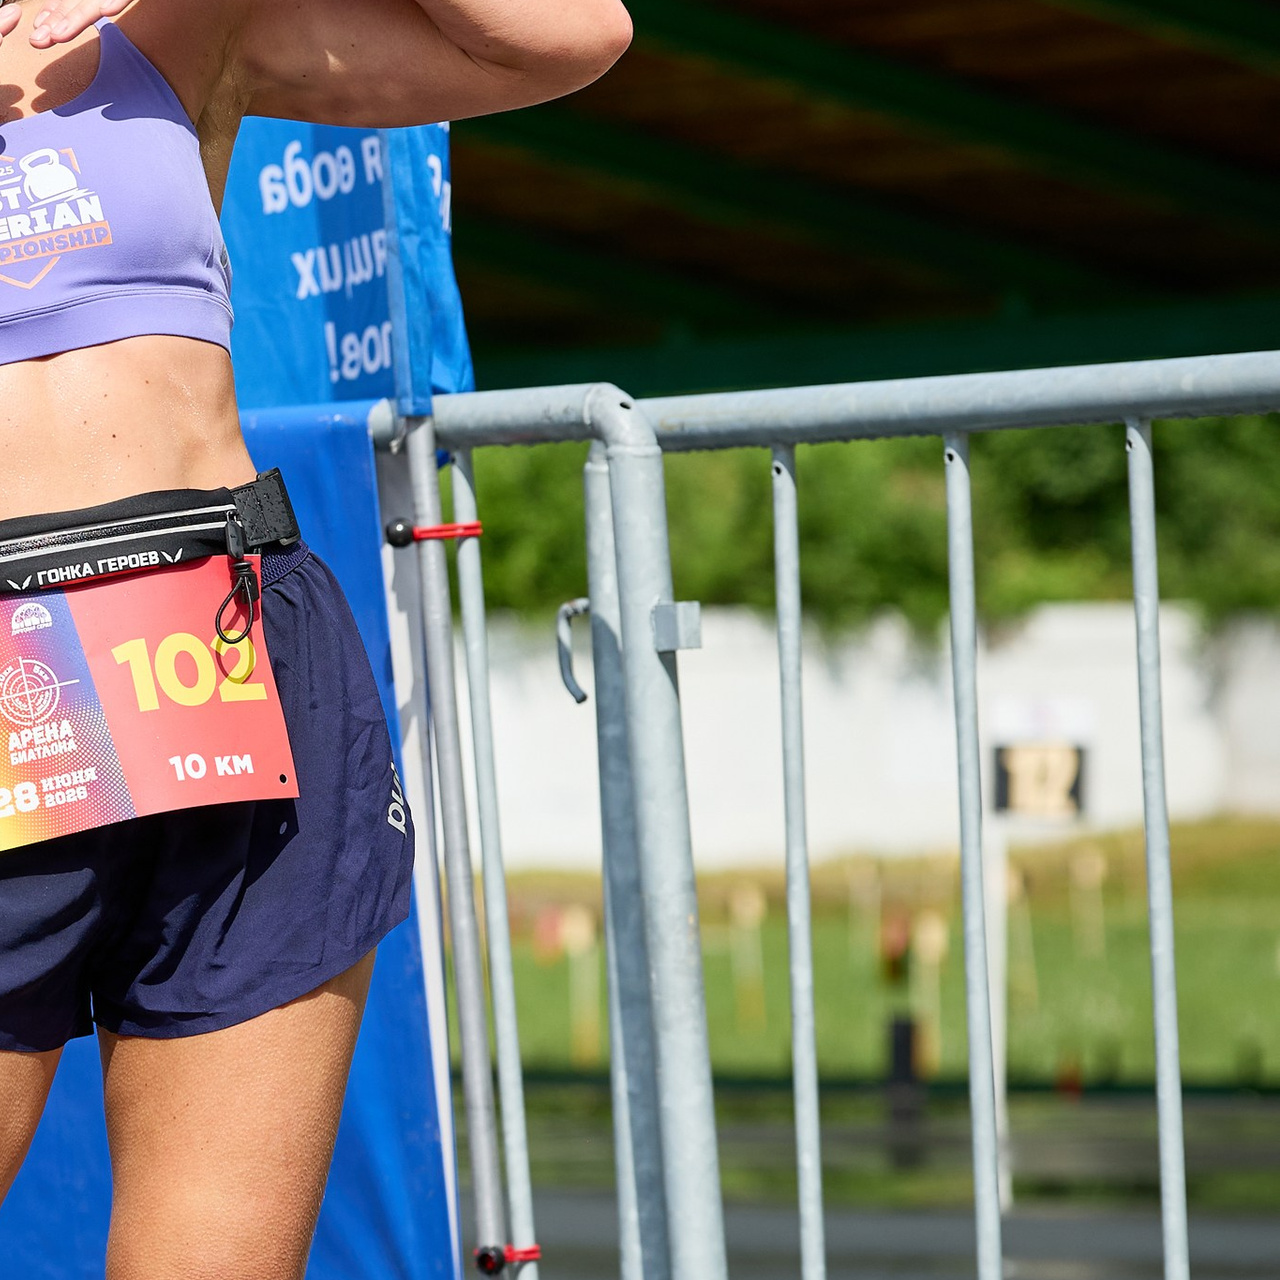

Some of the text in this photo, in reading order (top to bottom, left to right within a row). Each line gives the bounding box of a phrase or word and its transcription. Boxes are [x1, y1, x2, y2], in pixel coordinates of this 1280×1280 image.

[37, 550, 160, 586] ГОНКА ГЕРОЕВ
[110, 629, 268, 713] 102
[9, 720, 74, 751] АРЕНА
[11, 738, 76, 766] БИАТЛОНА
[168, 753, 207, 781] 10
[45, 786, 87, 808] 2026
